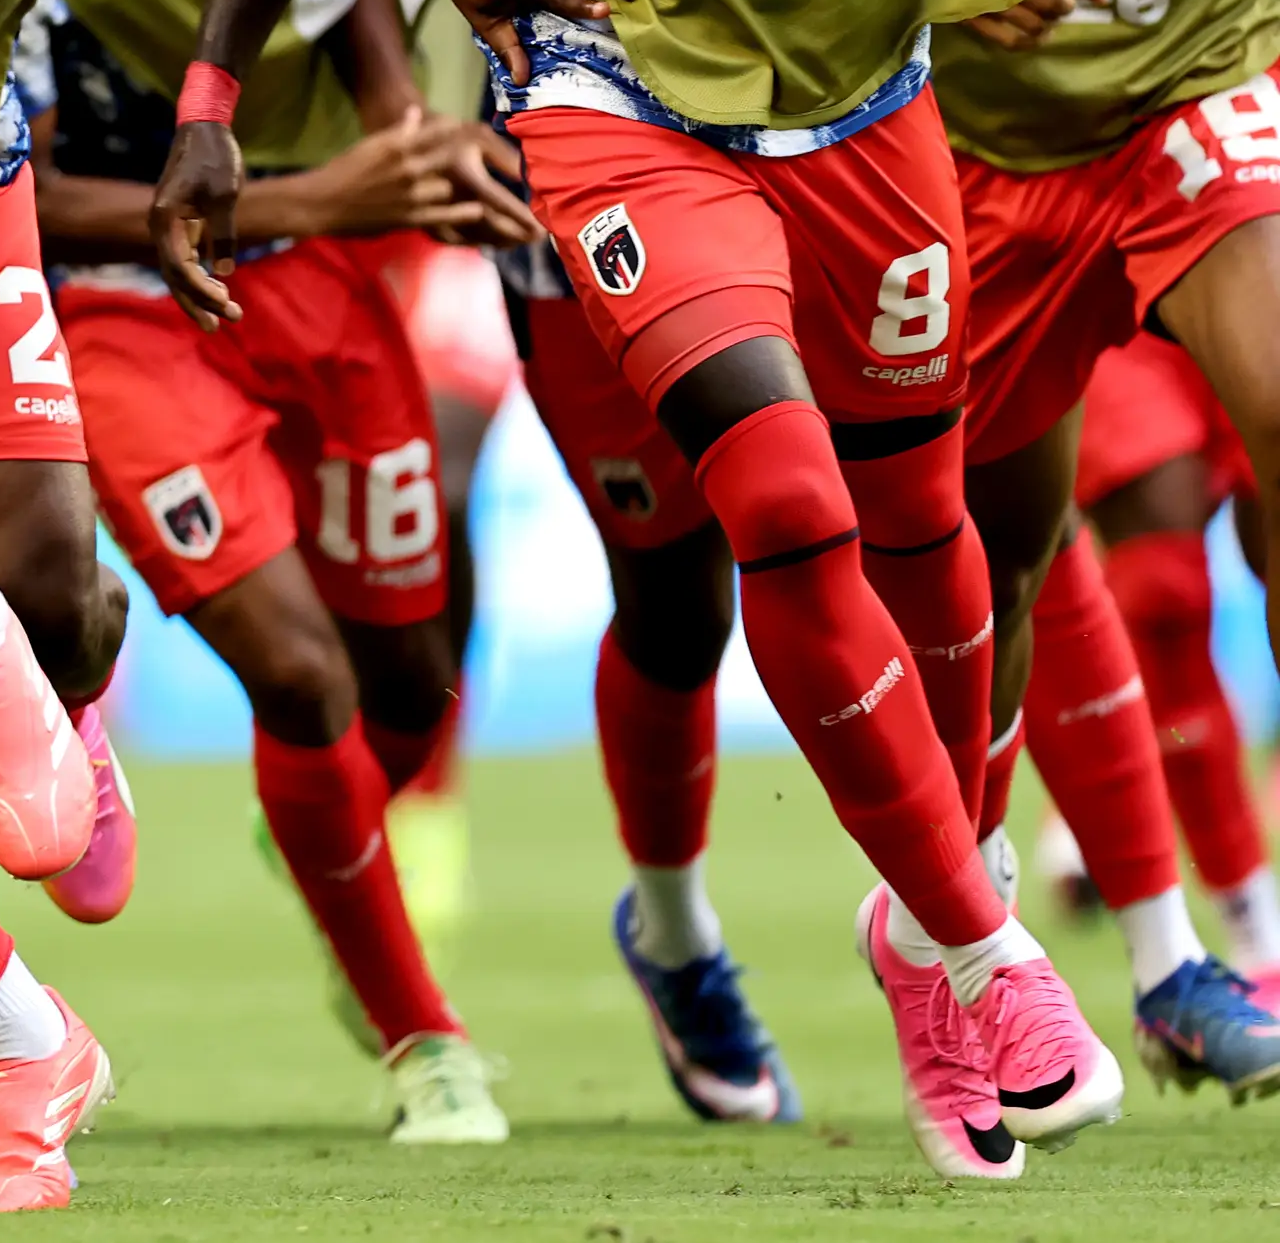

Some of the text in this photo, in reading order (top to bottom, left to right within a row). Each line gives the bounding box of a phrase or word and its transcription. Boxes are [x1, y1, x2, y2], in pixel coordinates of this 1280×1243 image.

[583, 207, 620, 246] FCF
[869, 241, 950, 356] 8
[861, 353, 949, 385] capelli
[315, 437, 439, 565] 16
